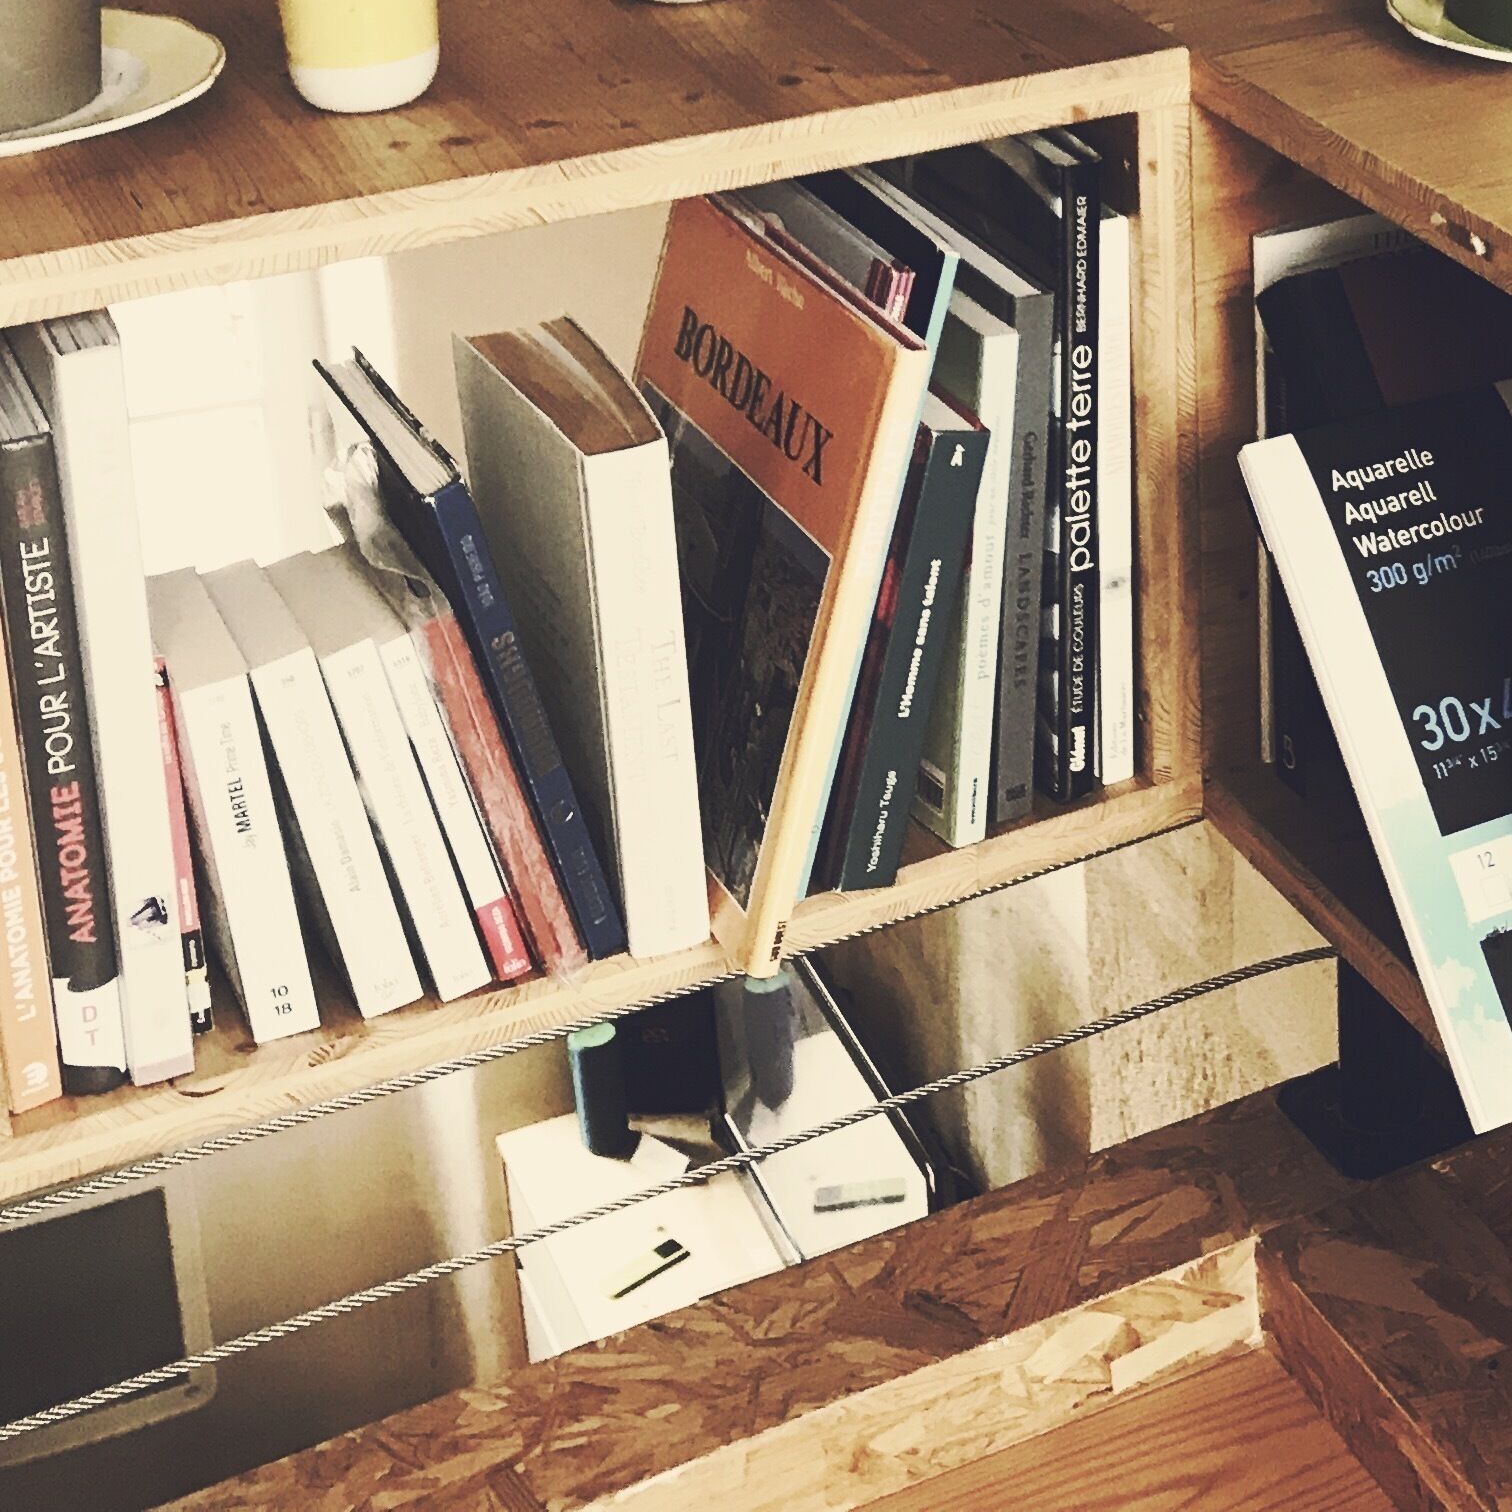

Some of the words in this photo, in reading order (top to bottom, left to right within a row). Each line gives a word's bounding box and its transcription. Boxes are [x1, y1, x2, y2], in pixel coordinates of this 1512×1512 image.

[1076, 261, 1087, 333] BERNHARD
[674, 305, 834, 487] BORDEAUX
[1066, 344, 1092, 431] terre
[1332, 448, 1434, 492] Aquarelle
[1065, 439, 1094, 572] palette
[1345, 481, 1437, 525] Aquarell
[1352, 507, 1485, 558] Watercolour
[921, 557, 943, 607] talent
[1366, 562, 1408, 593] 300
[20, 537, 66, 686] L'ARTISTE
[913, 607, 932, 645] sans
[1012, 551, 1032, 690] LANDSCAPES
[1073, 583, 1084, 652] COULEURS
[897, 646, 924, 719] L'Homme
[1072, 654, 1084, 672] DE
[40, 691, 75, 775] POUR
[225, 777, 252, 834] MARTEL
[0, 820, 17, 880] POUR
[51, 781, 97, 943] ANATOMIE
[865, 810, 889, 874] Yoshiharu
[1477, 851, 1496, 870] 12
[2, 884, 37, 1022] L'ANATOMIE
[82, 1005, 98, 1023] D
[270, 985, 288, 999] 10
[274, 1003, 292, 1017] 18
[84, 1029, 98, 1046] T
